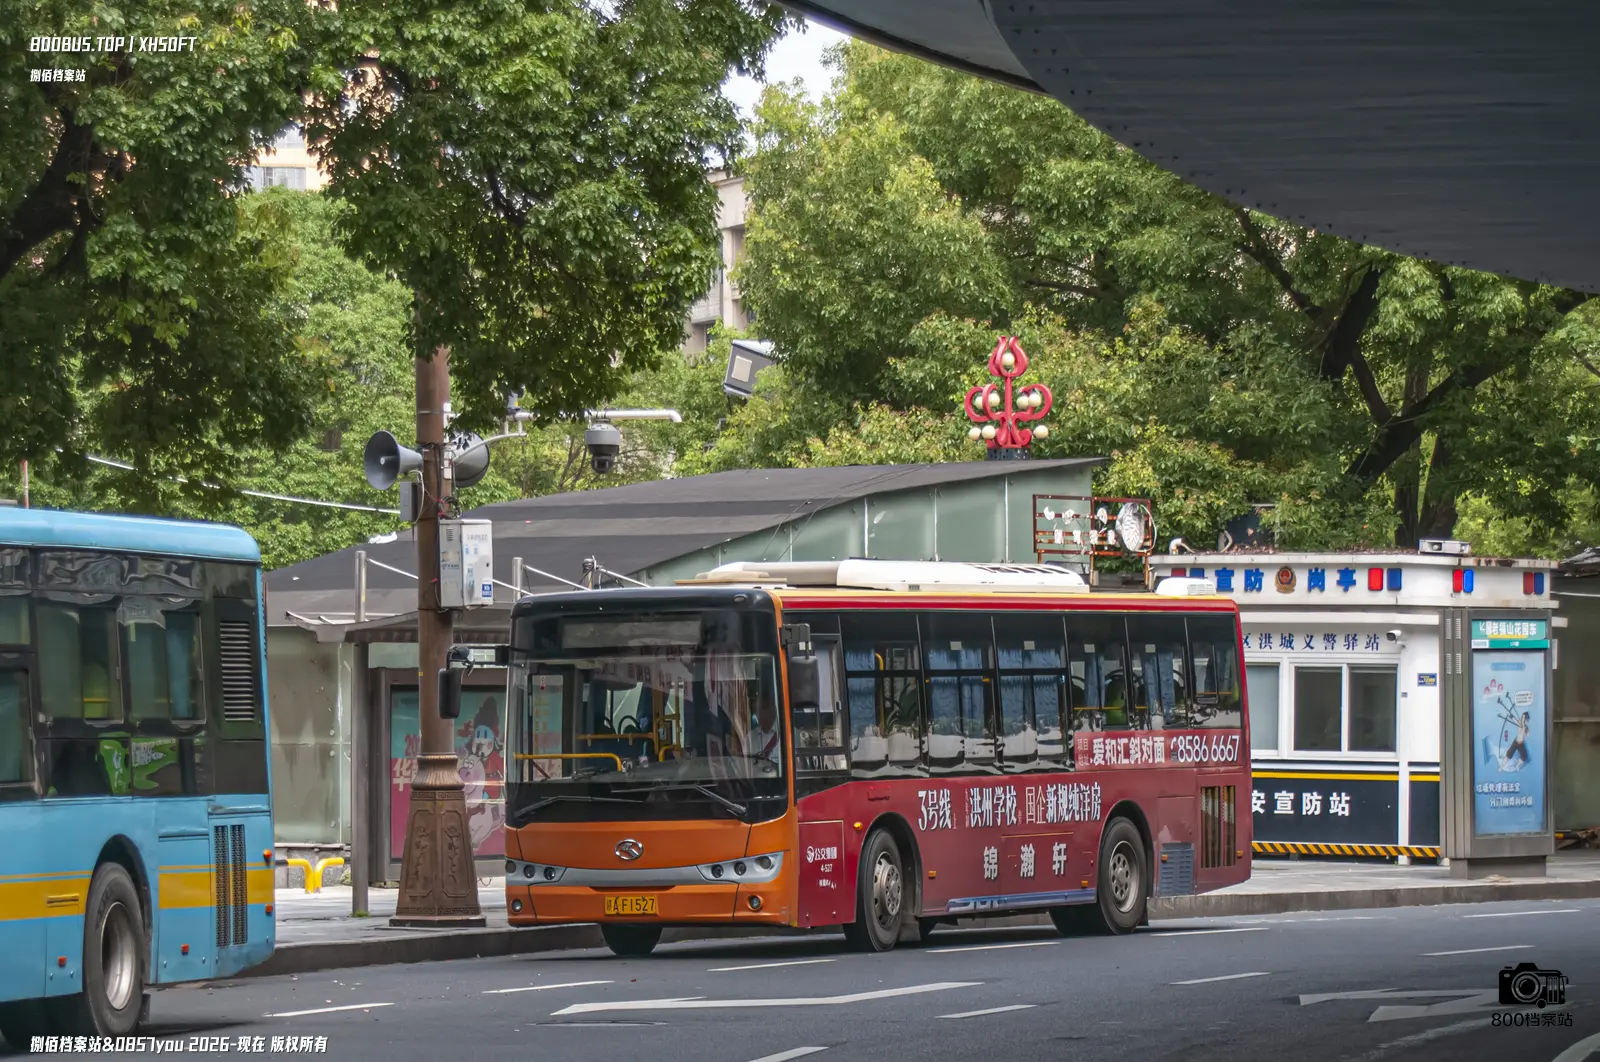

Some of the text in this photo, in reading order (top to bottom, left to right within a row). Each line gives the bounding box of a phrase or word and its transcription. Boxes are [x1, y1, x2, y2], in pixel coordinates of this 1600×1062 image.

[1214, 567, 1357, 593] 宣防 岗亭
[1242, 632, 1381, 651] 区洪城义警驿站
[1092, 734, 1240, 766] 爱和汇斜对面 8586 6667
[918, 788, 952, 831] 3号线
[969, 785, 1017, 828] 洪州学校
[1025, 781, 1102, 825] 国企新规纯洋房
[1251, 789, 1351, 817] 安宣防站
[983, 841, 1067, 880] 锦瀚轩
